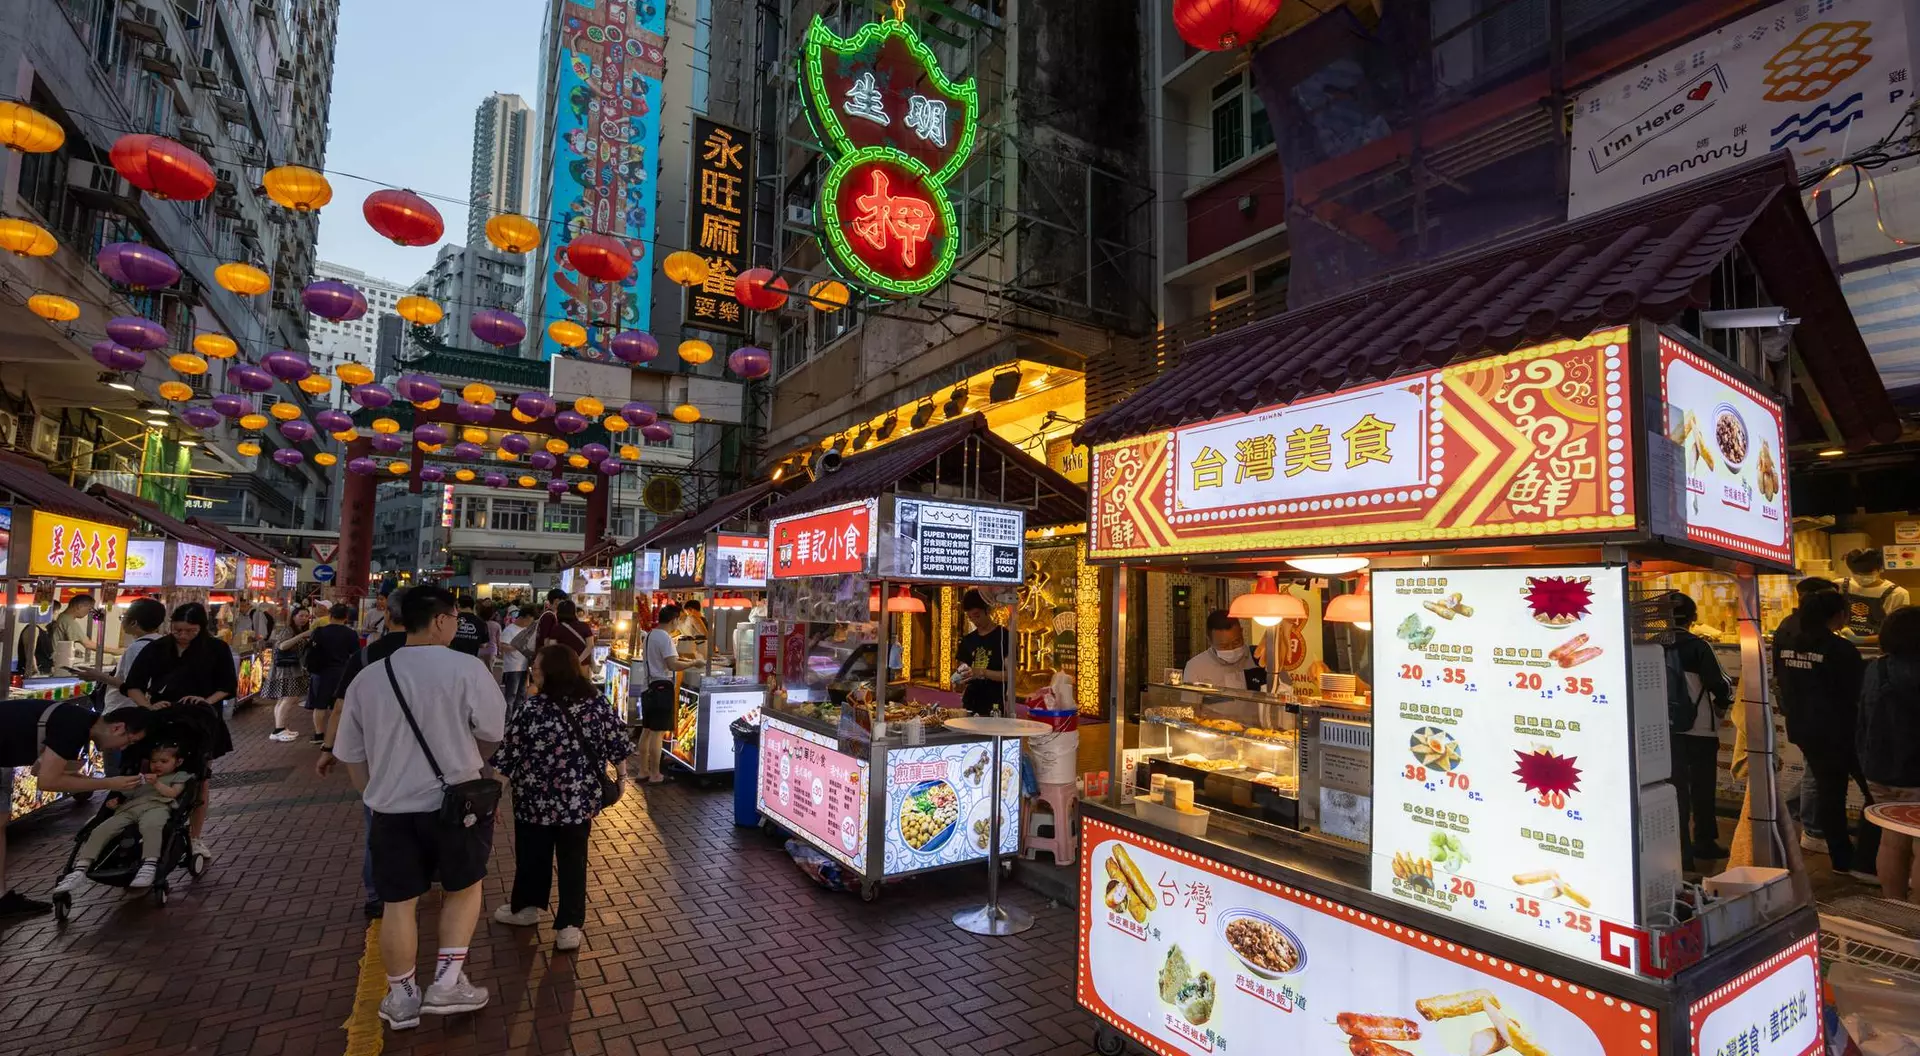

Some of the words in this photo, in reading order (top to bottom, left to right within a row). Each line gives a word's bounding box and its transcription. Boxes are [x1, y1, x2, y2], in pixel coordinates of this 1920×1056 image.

[1603, 134, 1633, 157] I'm
[1636, 101, 1685, 137] Here
[700, 127, 744, 297] 永旺麻雀
[852, 169, 935, 268] 押
[1258, 410, 1284, 423] TAIWAN
[1190, 411, 1397, 491] 台灣美食
[47, 524, 118, 571] 美食大王
[797, 522, 861, 565] 華記小食
[922, 530, 945, 539] SUPER
[946, 532, 970, 540] YUMMY
[922, 547, 945, 555] SUPER
[945, 549, 970, 557] YUMMY
[945, 565, 970, 573] YUMMY
[994, 557, 1017, 566] STREET
[996, 565, 1015, 573] FOOD
[1158, 871, 1213, 925] 台灣
[1282, 983, 1307, 1011] 地道
